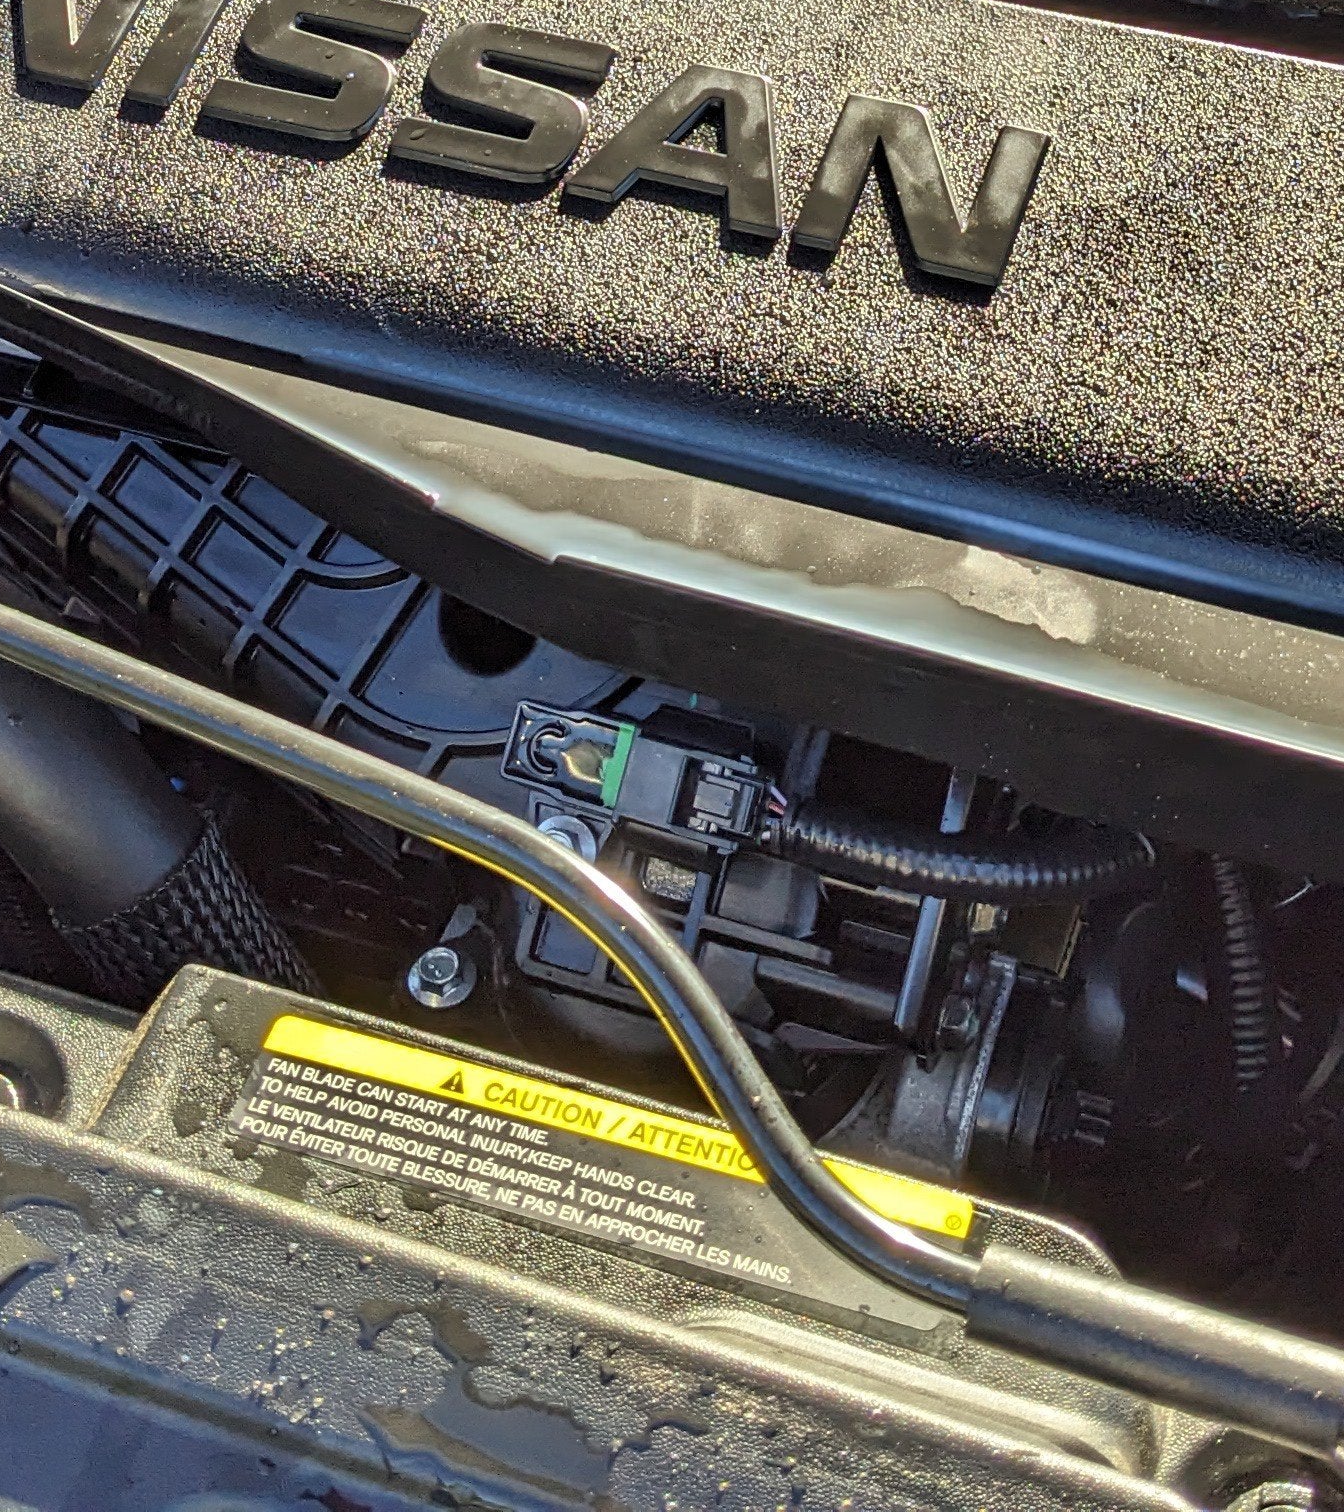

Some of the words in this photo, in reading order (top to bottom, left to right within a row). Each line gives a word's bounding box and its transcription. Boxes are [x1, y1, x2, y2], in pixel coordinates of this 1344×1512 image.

[247, 1097, 268, 1114] LE
[272, 1102, 377, 1145] VENTILATEUR
[376, 1133, 439, 1162] RISQUE
[440, 1150, 467, 1169] DE
[468, 1154, 562, 1195] DÉMARRER
[561, 1177, 577, 1199] À
[578, 1188, 625, 1214] TOUT
[625, 1203, 706, 1237] MOMENT.
[260, 1076, 283, 1092] TO
[283, 1080, 328, 1105] HELP
[326, 1095, 379, 1121] AVOID
[379, 1108, 468, 1147] PERSONAL
[574, 1163, 635, 1192] HANDS
[637, 1180, 696, 1209] CLEAR.
[267, 1058, 302, 1077] FAN
[302, 1065, 357, 1093] BLADE
[357, 1082, 394, 1103] CAN
[394, 1092, 449, 1118] START
[448, 1108, 472, 1124] AT
[470, 1113, 507, 1134] ANY
[510, 1122, 549, 1146] TIME.
[485, 1082, 605, 1130] CAUTION
[607, 1117, 626, 1134] /
[628, 1122, 758, 1171] ATTENTIO
[239, 1116, 288, 1139] POUR
[288, 1125, 346, 1157] ÉVITER
[346, 1147, 405, 1173] TOUTE
[401, 1160, 491, 1201] BLESSURE,
[494, 1187, 519, 1207] NE
[521, 1195, 558, 1217] PAS
[558, 1205, 585, 1224] EN
[585, 1212, 696, 1256] APPROCHER
[696, 1243, 731, 1268] LES
[731, 1252, 792, 1285] MAINS.
